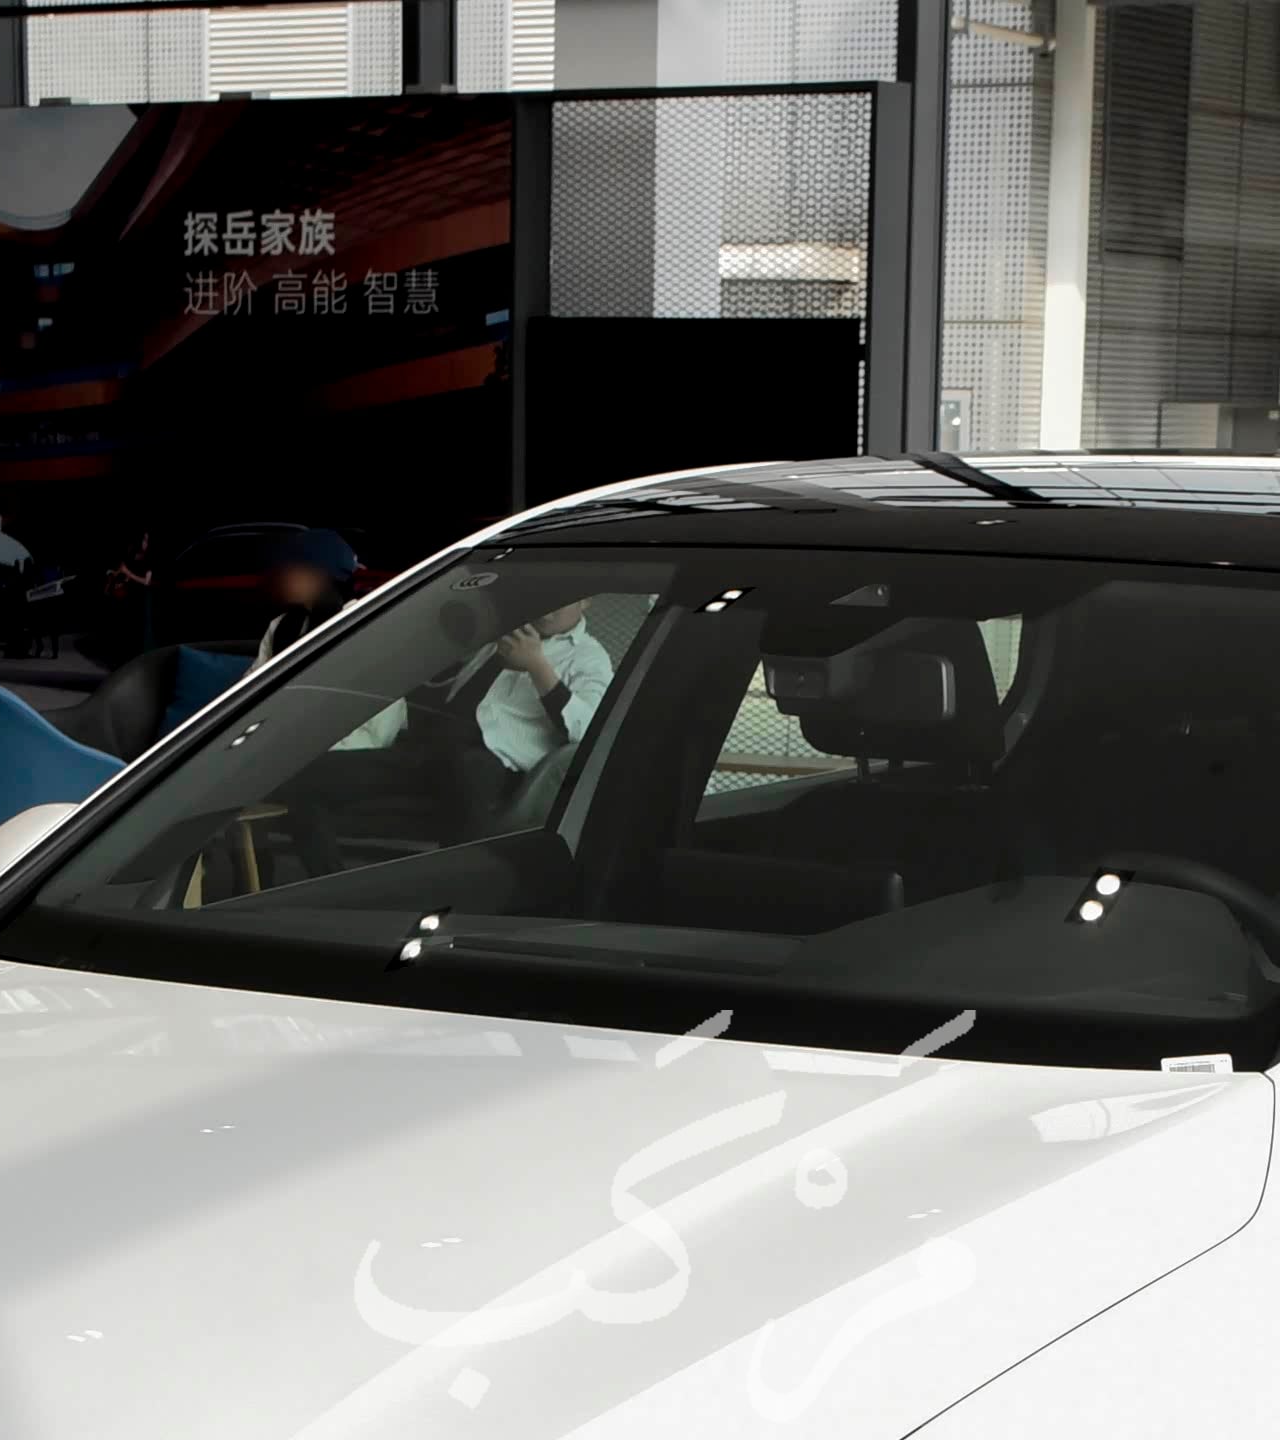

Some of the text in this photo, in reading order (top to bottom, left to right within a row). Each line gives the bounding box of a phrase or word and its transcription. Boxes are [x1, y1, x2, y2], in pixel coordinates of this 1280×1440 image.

[184, 209, 335, 256] 探岳家族
[185, 269, 438, 315] 进阶 高能 智慧
